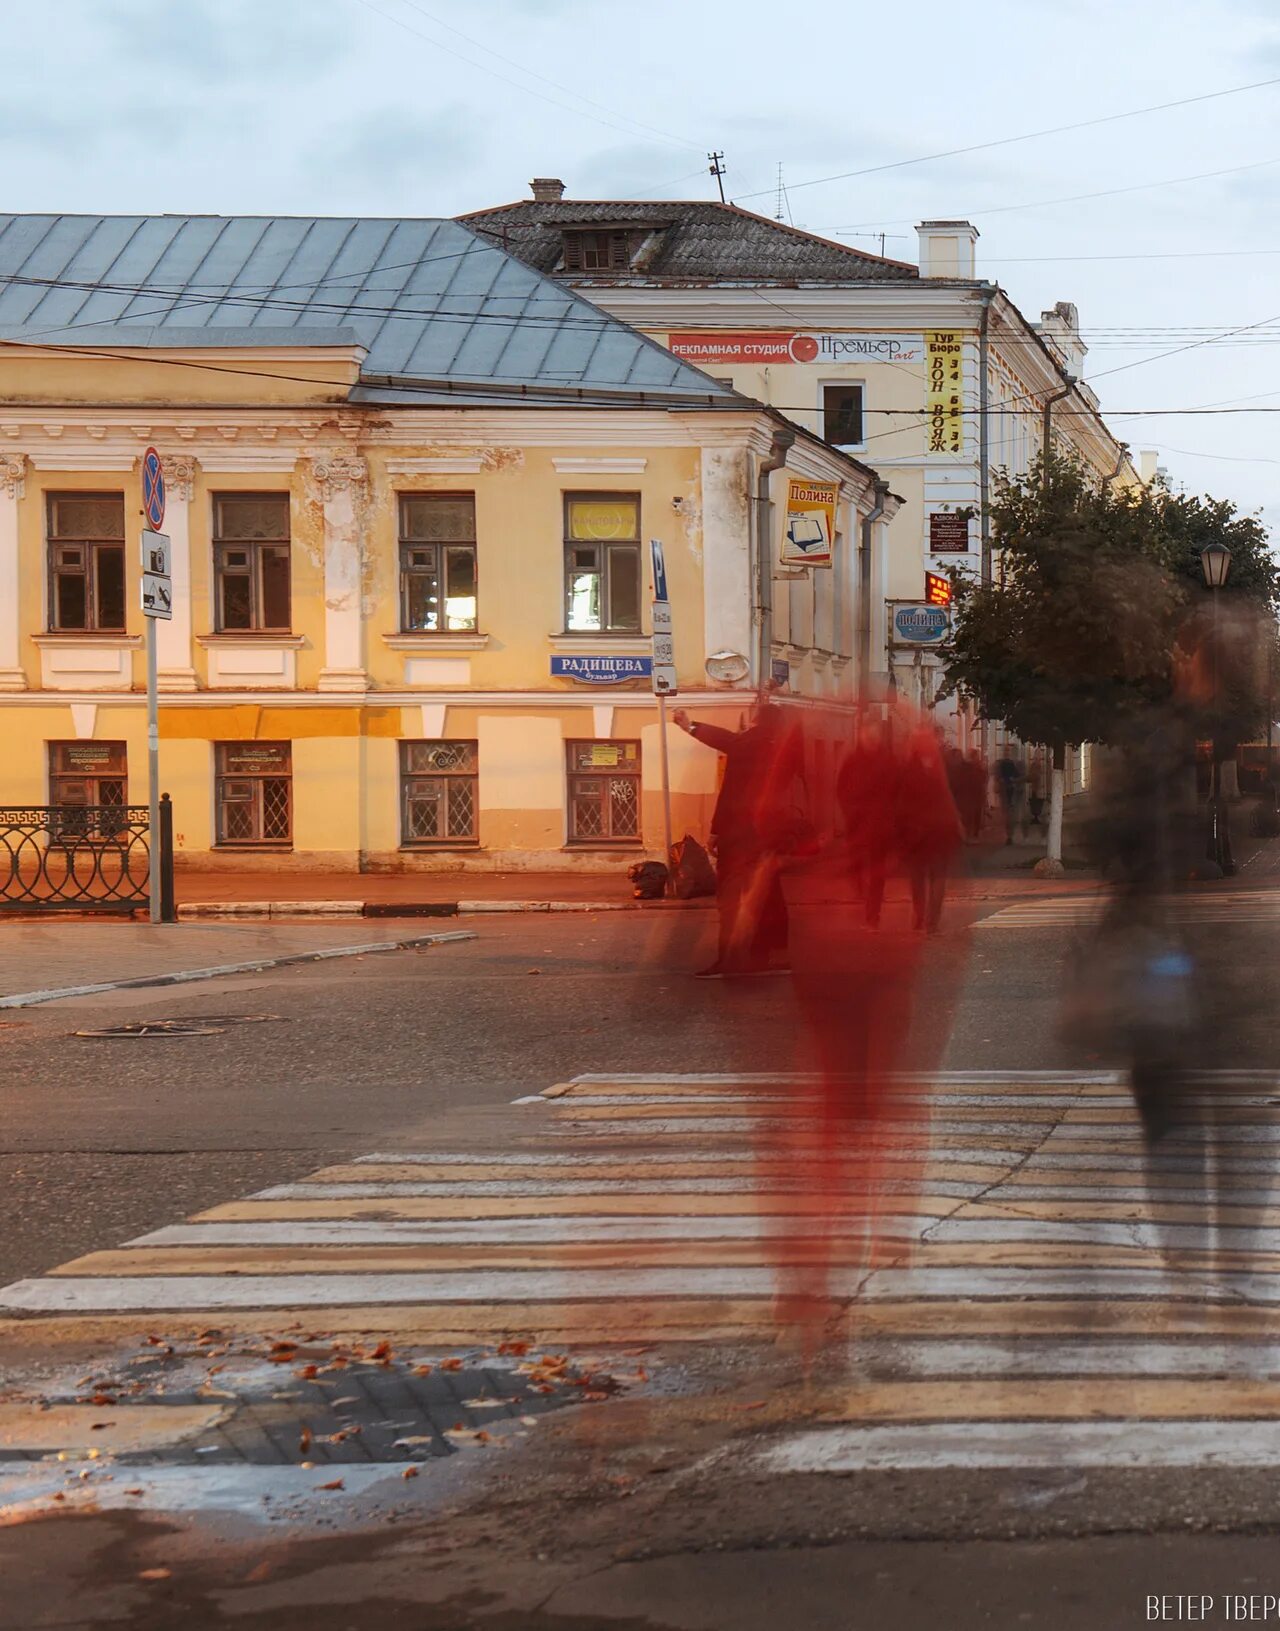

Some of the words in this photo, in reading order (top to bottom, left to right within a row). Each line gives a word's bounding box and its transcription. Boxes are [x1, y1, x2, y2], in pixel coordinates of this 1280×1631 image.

[934, 333, 954, 343] Тур
[672, 344, 741, 355] РЕКЛАМНАЯ
[744, 344, 788, 356] СТУДИЯ
[821, 335, 901, 360] Премьер
[929, 343, 961, 354] Бюро
[931, 357, 945, 392] БОН
[929, 404, 947, 452] ВОЯЖ
[790, 485, 834, 503] Полина
[562, 659, 643, 673] РАДИЩЕВА
[585, 671, 618, 681] бульвар
